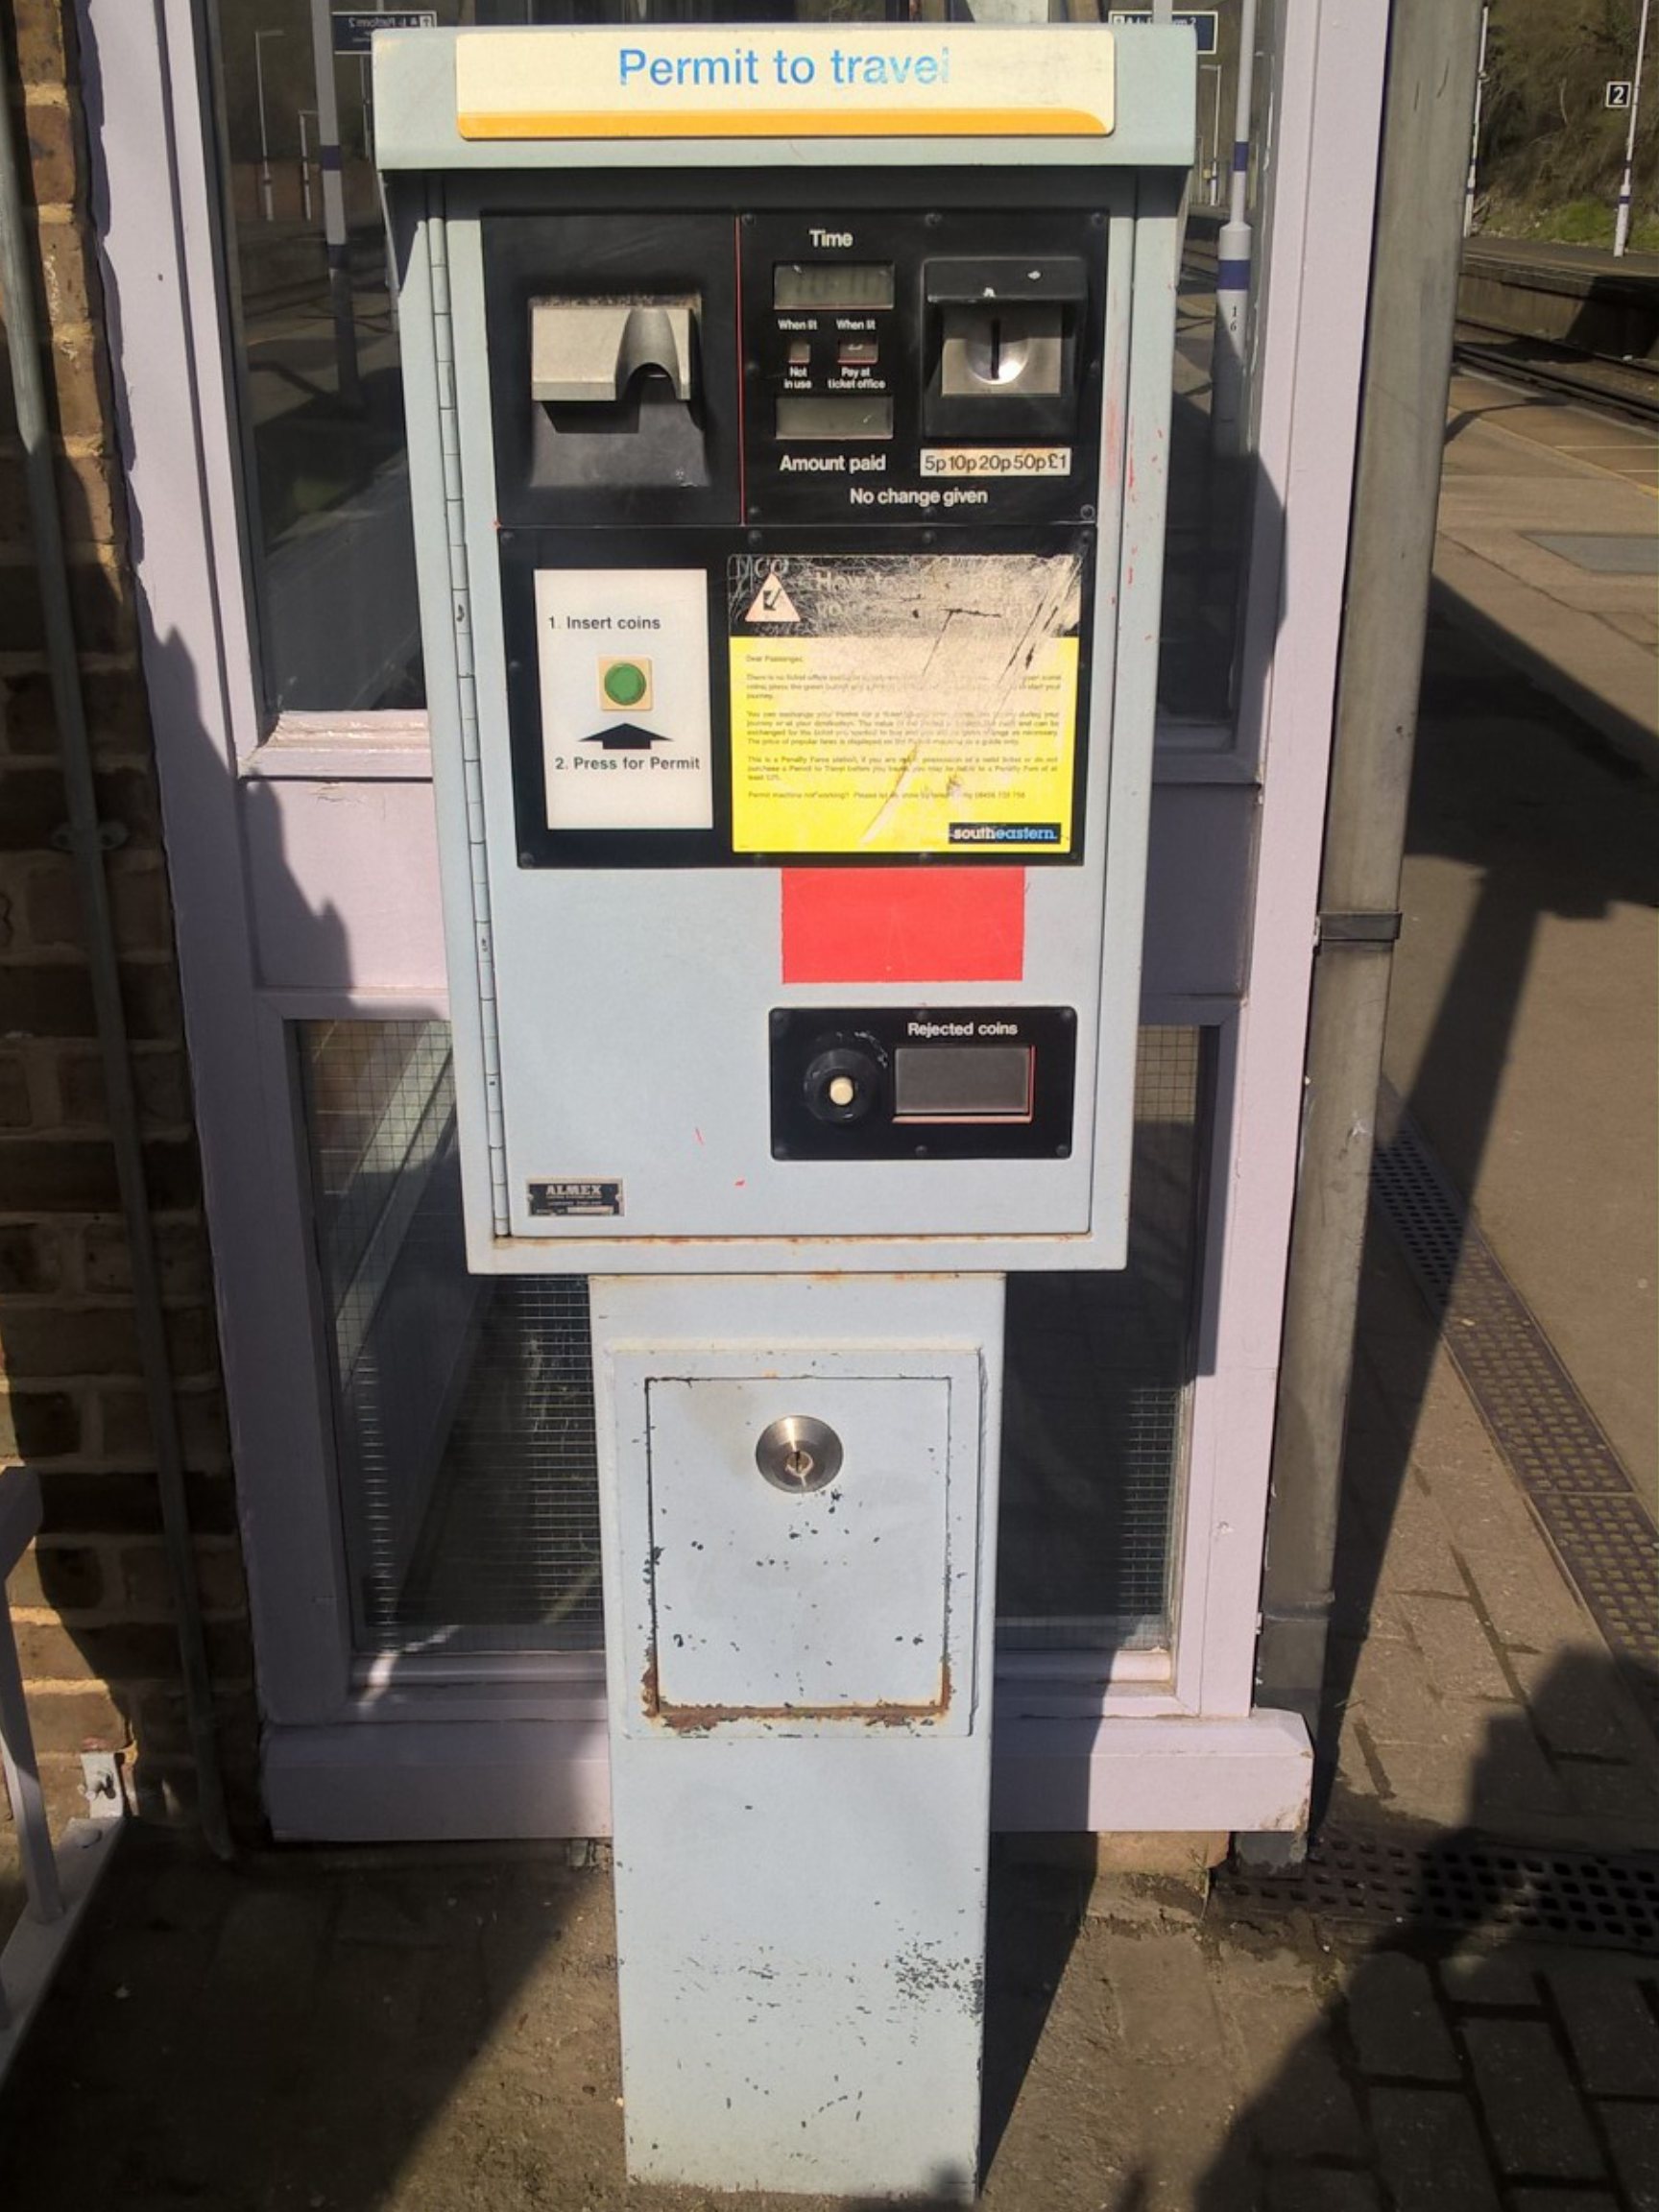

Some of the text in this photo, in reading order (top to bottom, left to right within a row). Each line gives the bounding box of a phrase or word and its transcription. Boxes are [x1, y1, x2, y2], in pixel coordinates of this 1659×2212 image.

[618, 47, 950, 86] Permit to travel
[1612, 85, 1624, 105] 2
[809, 229, 854, 248] Time
[778, 319, 805, 330] When
[835, 319, 864, 330] When
[789, 366, 807, 377] Not
[841, 366, 870, 379] Pay at
[783, 378, 812, 389] in use
[828, 378, 886, 389] ticket office
[779, 454, 886, 473] Amount paid
[925, 454, 1067, 473] 5p 10p 20p 50p £1
[850, 488, 988, 507] No change given
[548, 616, 661, 630] 1. Insert coins
[554, 757, 701, 770] 2. Press for Permit
[907, 1022, 1018, 1037] Rejected coins
[545, 1184, 603, 1196] ALMEX
